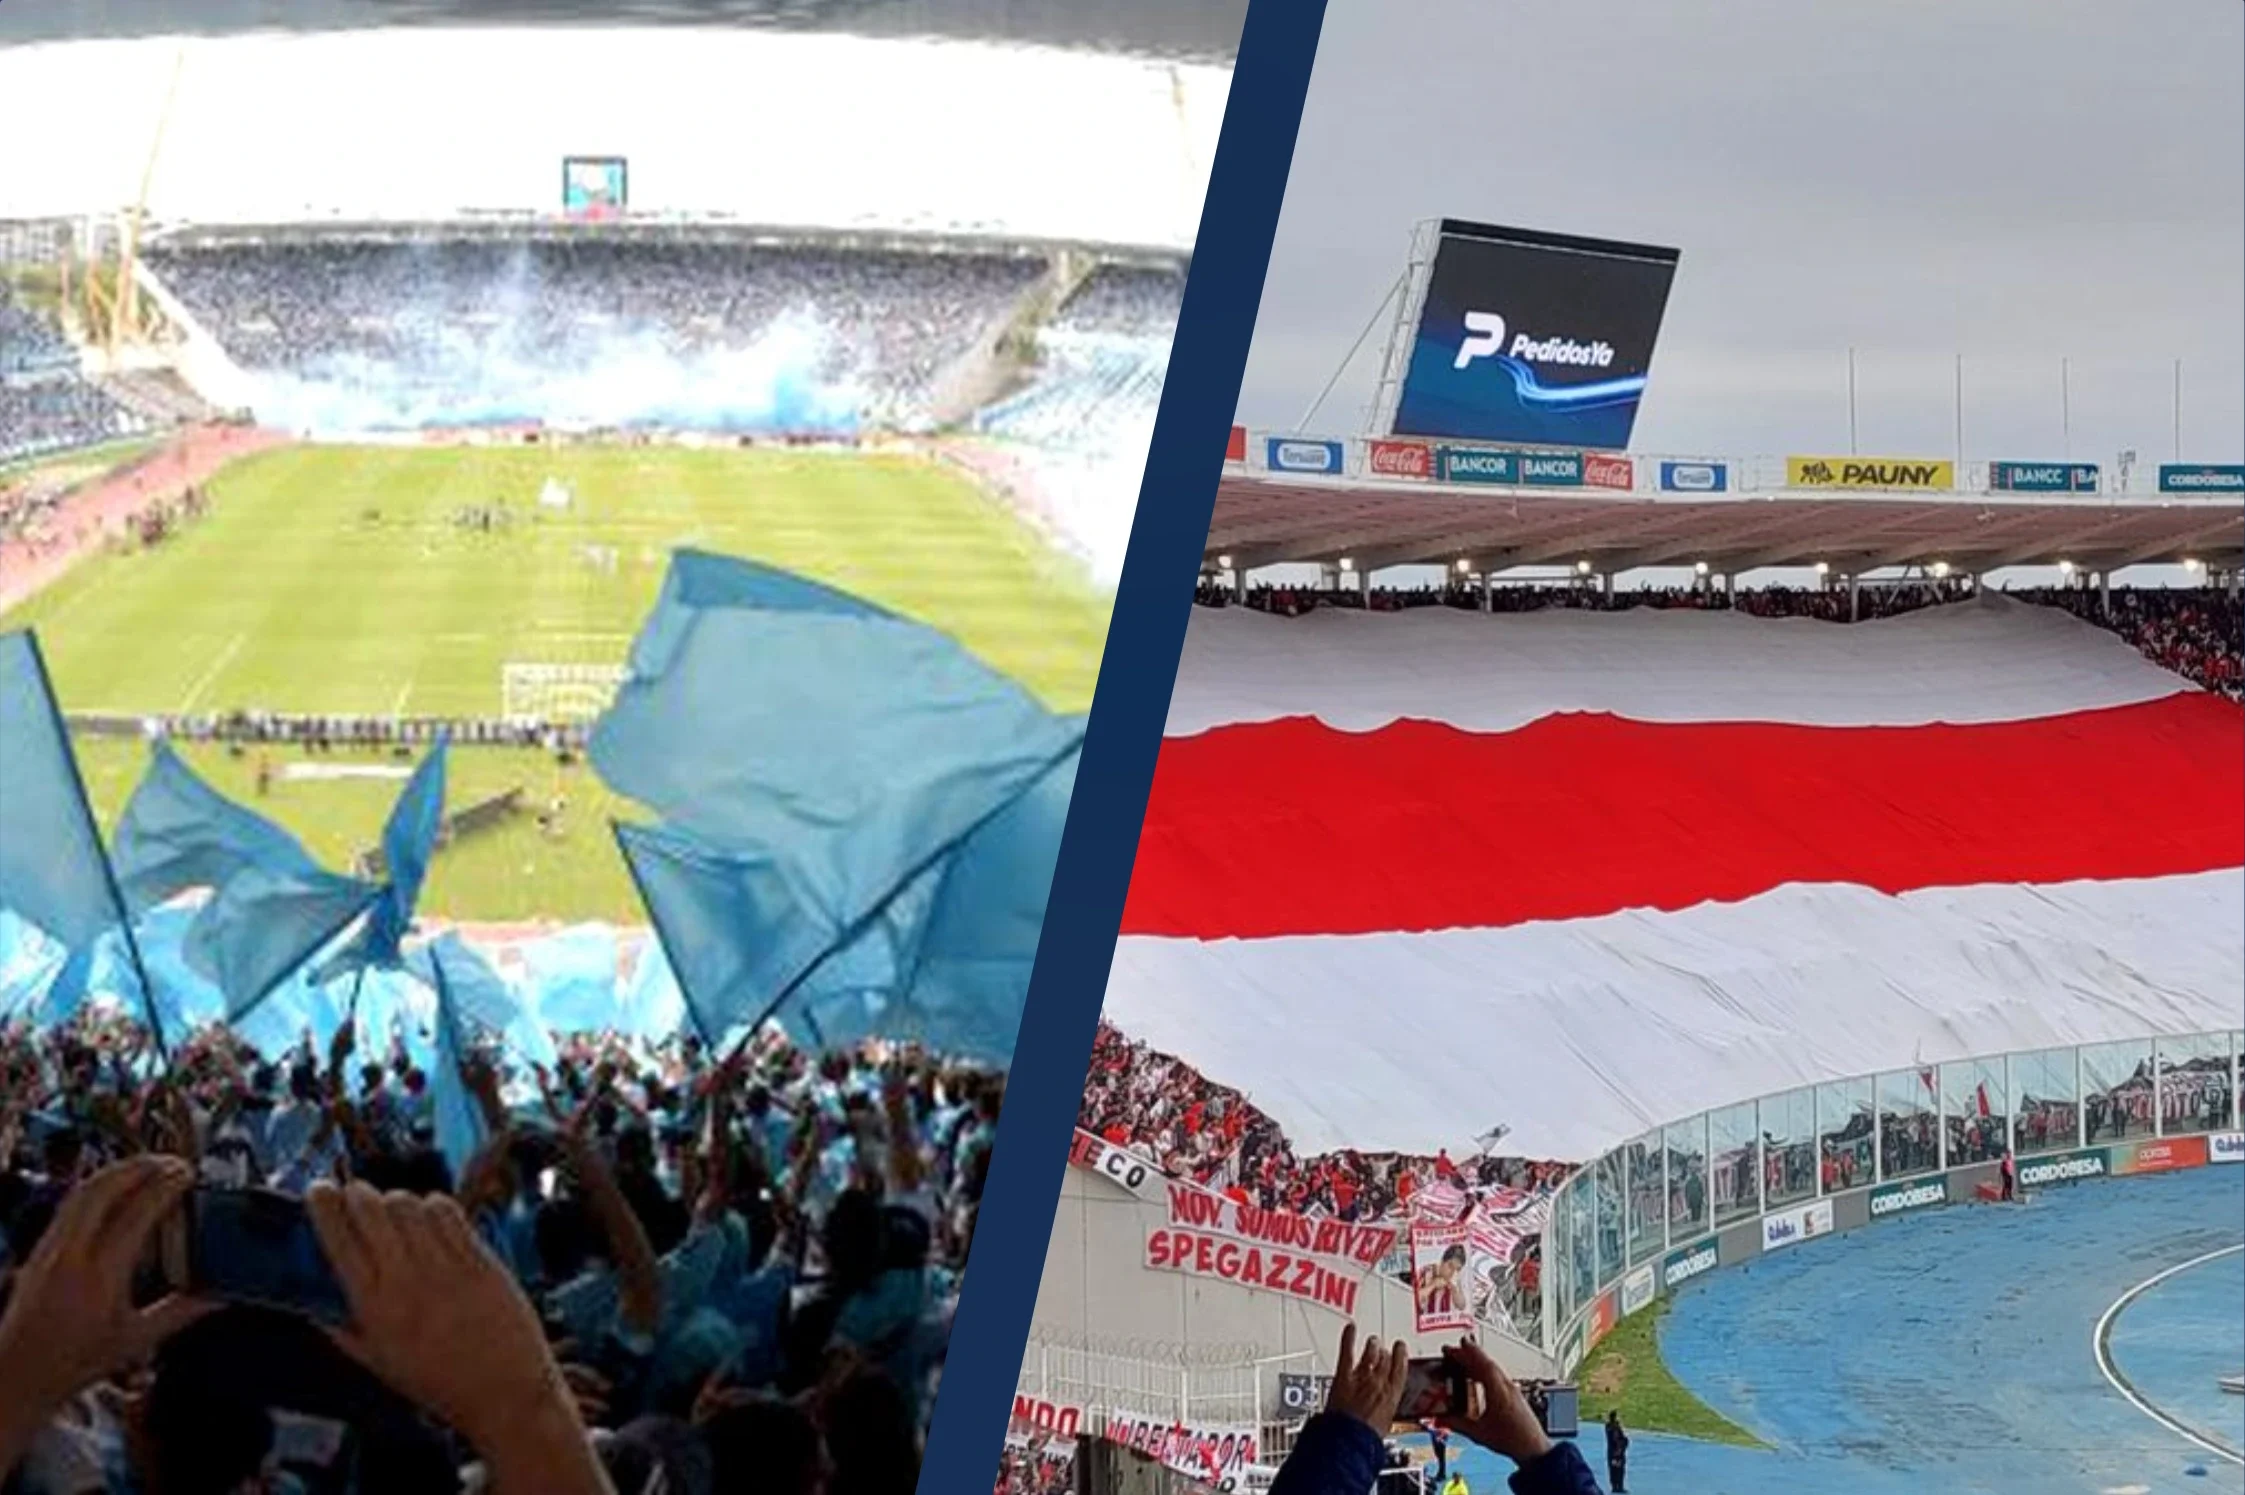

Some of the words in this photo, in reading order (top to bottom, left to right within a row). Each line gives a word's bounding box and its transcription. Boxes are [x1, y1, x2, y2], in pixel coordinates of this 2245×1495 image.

[1508, 333, 1615, 367] PedidosYa
[1451, 456, 1507, 475] BANCOR
[1525, 461, 1578, 478] BANCOR
[1842, 463, 1939, 486] PAUNY
[2167, 473, 2244, 487] CORDOBESA
[2020, 1156, 2104, 1185] CORDOBESA
[1870, 1183, 1946, 1215] CORDOBESA
[1147, 1229, 1358, 1316] SPEGAZZINI
